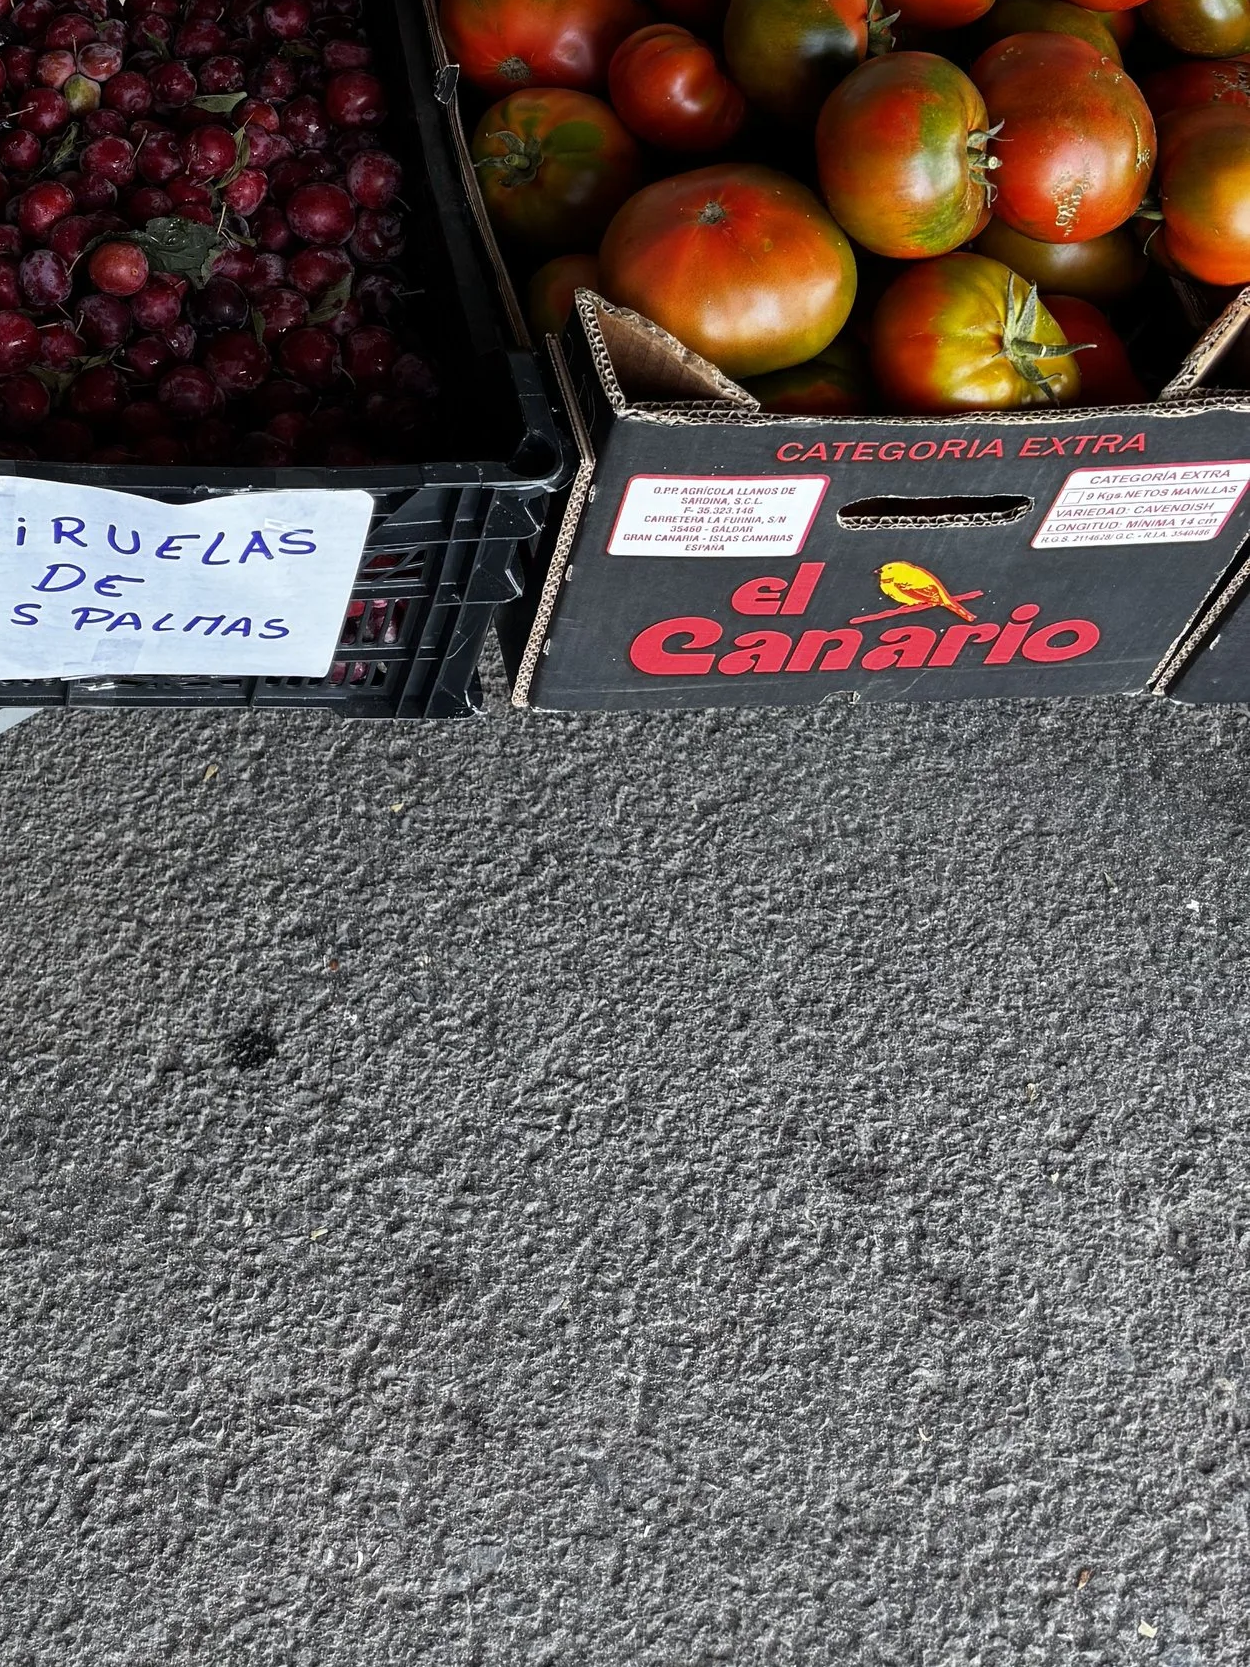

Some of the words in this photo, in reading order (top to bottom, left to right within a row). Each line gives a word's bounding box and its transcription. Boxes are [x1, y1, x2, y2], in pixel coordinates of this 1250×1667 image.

[776, 438, 1004, 462] CATEGORIA
[1019, 432, 1147, 458] EXTRA
[1090, 470, 1177, 484] CATEGORÍA
[1181, 470, 1231, 480] EXTRA
[680, 486, 734, 495] AGRÍCOLA
[737, 487, 778, 495] LLANOS
[780, 487, 797, 495] DE
[1086, 492, 1095, 501] 9
[1170, 485, 1238, 496] MANILLAS
[681, 497, 730, 506] SARDINA,
[733, 497, 763, 505] S.C.L.
[697, 507, 754, 515] 35.323.146
[1056, 506, 1130, 518] VARIEDAD:
[1134, 502, 1215, 515] CAVENDISH
[644, 515, 705, 524] CARRETERA
[707, 516, 722, 524] LA
[767, 516, 787, 524] S/N
[1047, 521, 1123, 532] LONGITUD:
[1126, 517, 1175, 529] MÍNIMA
[1180, 518, 1194, 527] 14
[1197, 517, 1218, 526] cm
[670, 525, 702, 533] 35460
[623, 534, 652, 542] GRAN
[654, 534, 700, 542] CANARIA
[741, 534, 794, 542] CANARIAS
[685, 543, 725, 551] ESPAÑA
[31, 563, 145, 598] DE
[730, 562, 826, 616] el
[71, 606, 290, 640] PALMAS
[628, 603, 1101, 675] Canario
